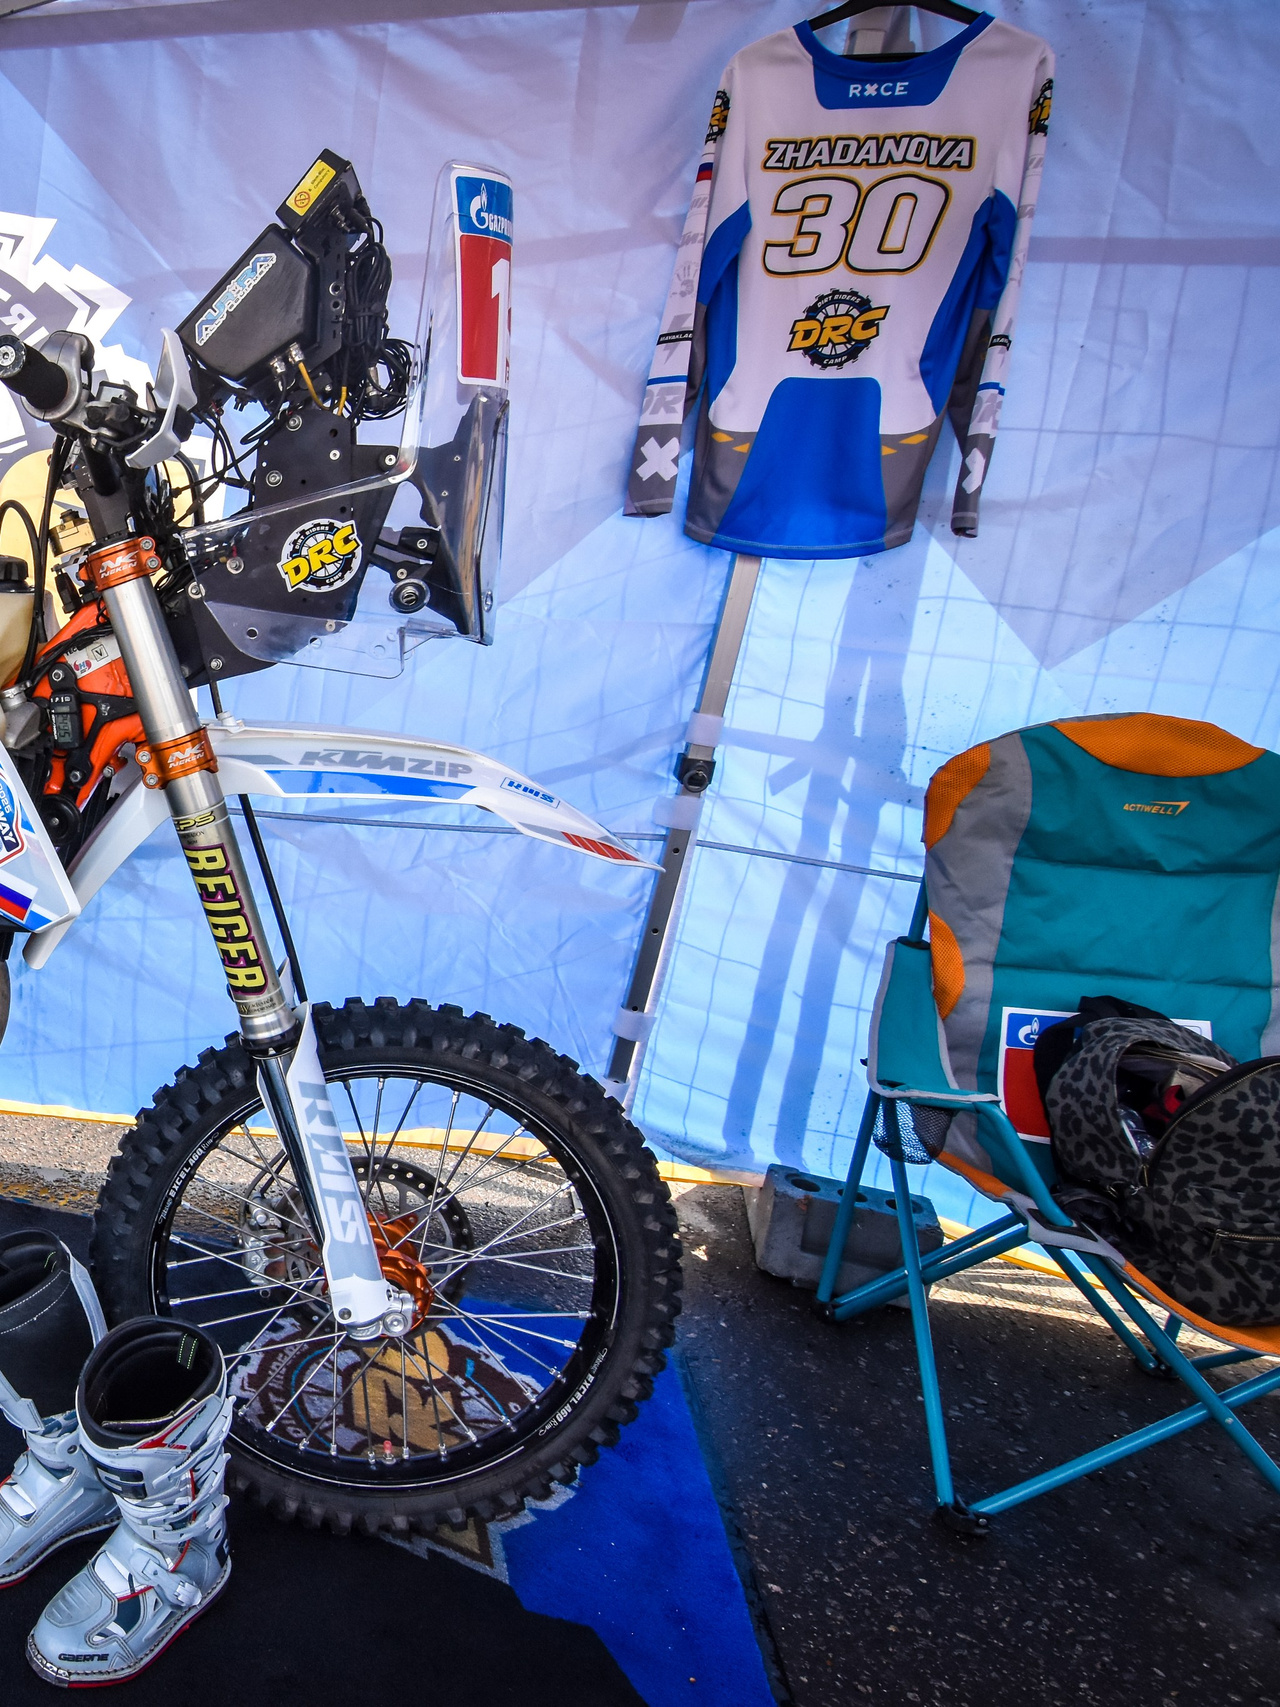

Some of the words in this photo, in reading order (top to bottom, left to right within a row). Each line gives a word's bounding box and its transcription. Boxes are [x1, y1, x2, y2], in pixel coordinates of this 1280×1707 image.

[762, 133, 975, 171] ZHADANOVA
[761, 171, 953, 278] 30
[788, 306, 889, 351] DRC
[823, 355, 848, 365] CAMP
[295, 536, 305, 550] DIRT
[305, 526, 329, 536] RIDERS
[282, 525, 359, 587] DRC
[325, 572, 343, 584] CAMP
[299, 749, 473, 778] KTMZIP
[1123, 803, 1173, 815] ACTIWELL
[183, 847, 267, 993] REIGER
[170, 1166, 190, 1199] EXCEL
[188, 1147, 205, 1170] A60
[570, 1372, 595, 1404] EXCEL
